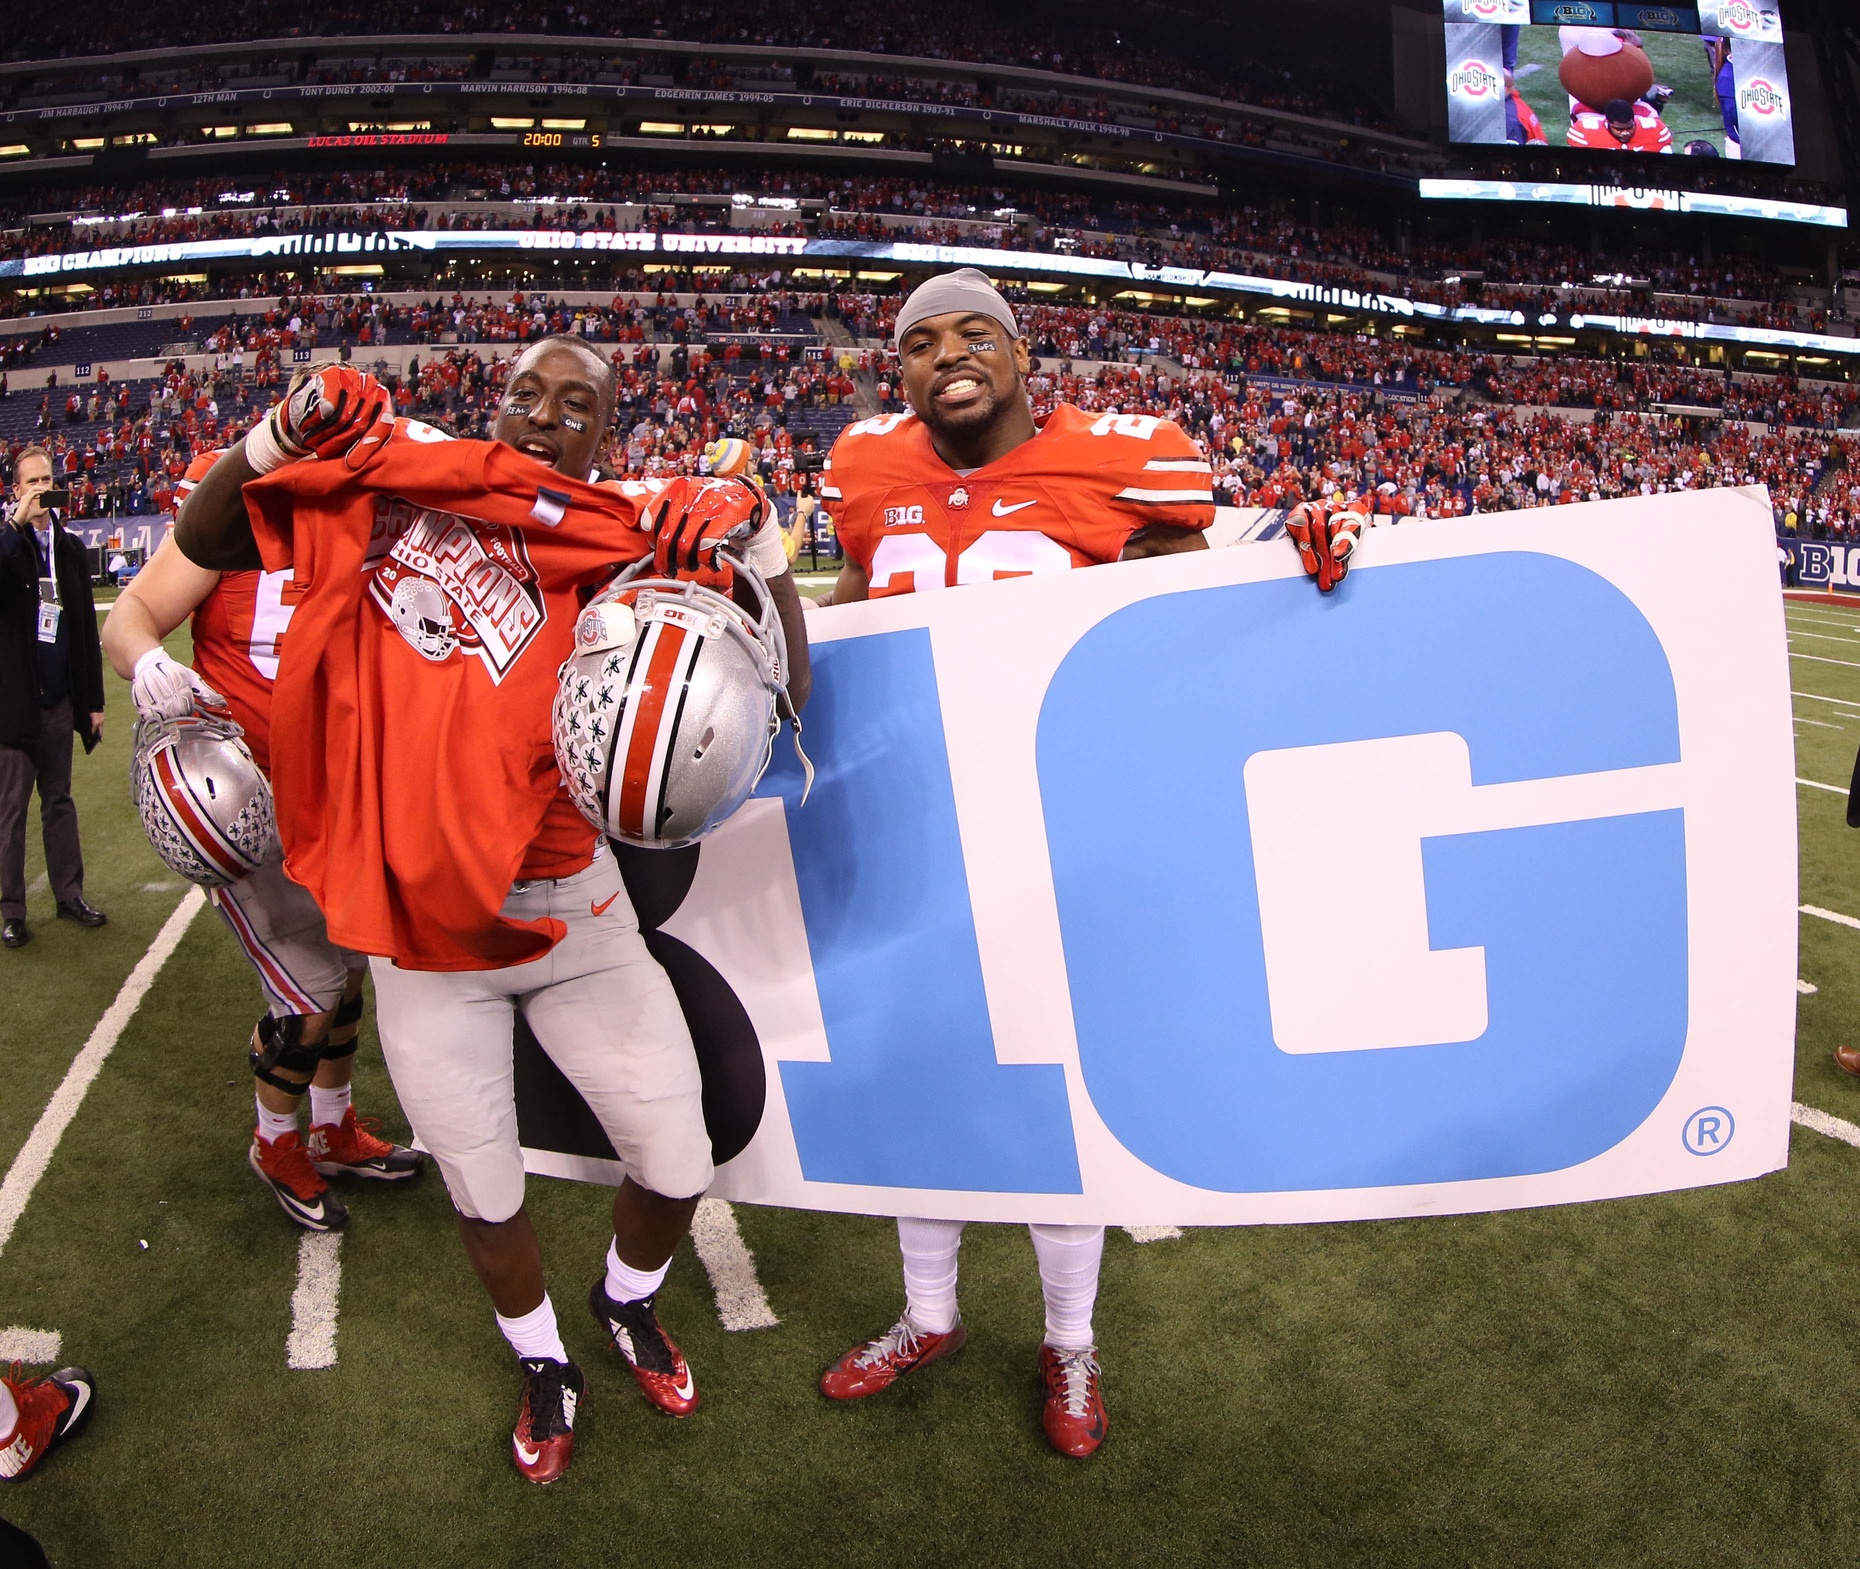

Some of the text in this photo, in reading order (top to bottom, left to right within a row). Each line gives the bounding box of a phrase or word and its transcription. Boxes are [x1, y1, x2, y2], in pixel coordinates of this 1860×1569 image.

[300, 85, 395, 96] TONY DUNGY 2002-08
[460, 83, 588, 95] MARVIN HARRISON 1996-08
[192, 92, 237, 104] 12TH MAN
[654, 89, 774, 103] EDGERRIN JAMES 1999-05
[39, 102, 134, 118] JIM HARBAUGH 1994-97
[840, 99, 956, 116] ERIC DICKERSON 1987-91
[1019, 115, 1130, 137] MARSHALL FAULK 1994-98
[308, 134, 449, 147] LUCAS OIL STADIUM
[523, 133, 562, 146] 20:00
[519, 231, 807, 255] OHIO STATE UNIVERSITY
[294, 352, 309, 360] 113
[807, 351, 822, 360] 115
[76, 366, 90, 375] 112
[565, 418, 583, 431] ONE
[490, 536, 524, 575] FOOTBALL
[382, 566, 397, 581] 20
[435, 566, 483, 626] STATE
